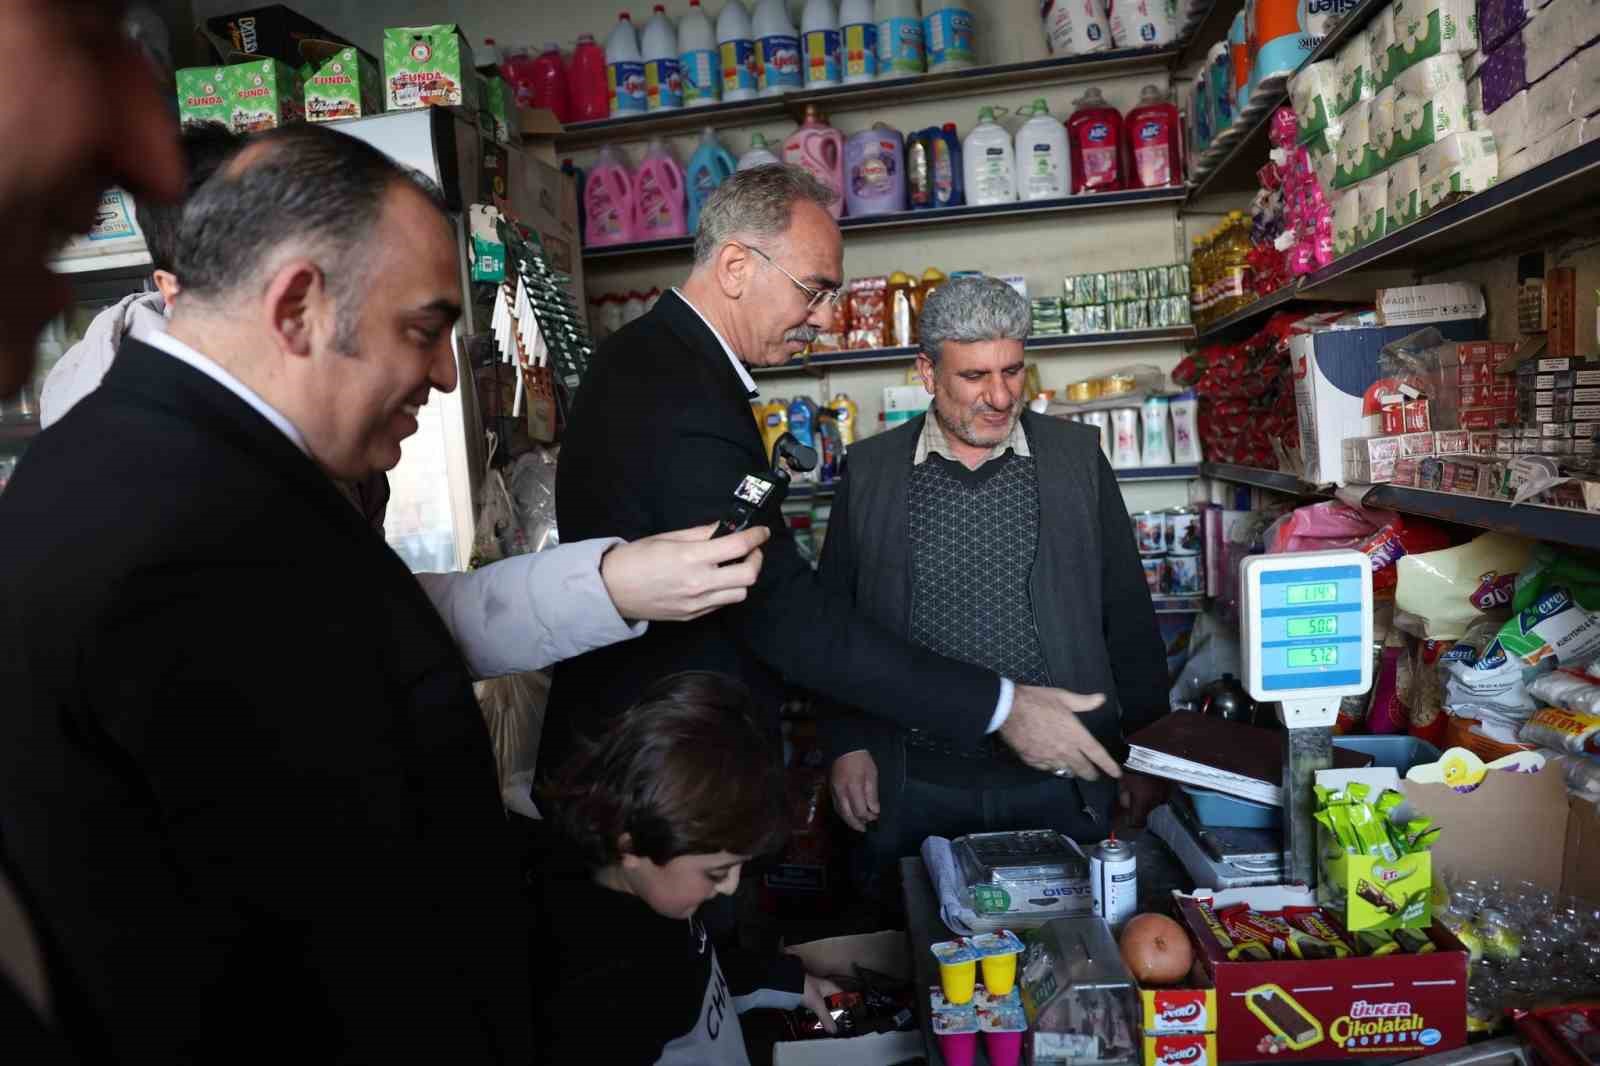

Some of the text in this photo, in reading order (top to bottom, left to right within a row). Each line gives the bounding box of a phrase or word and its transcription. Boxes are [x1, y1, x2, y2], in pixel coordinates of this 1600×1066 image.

[313, 75, 352, 85] FUNDA
[400, 71, 443, 82] FUNDA
[238, 86, 272, 98] FUNDA
[187, 95, 224, 107] FUNDA
[1350, 1000, 1411, 1018] ÜLKER
[1329, 1013, 1424, 1049] Çikolatalı
